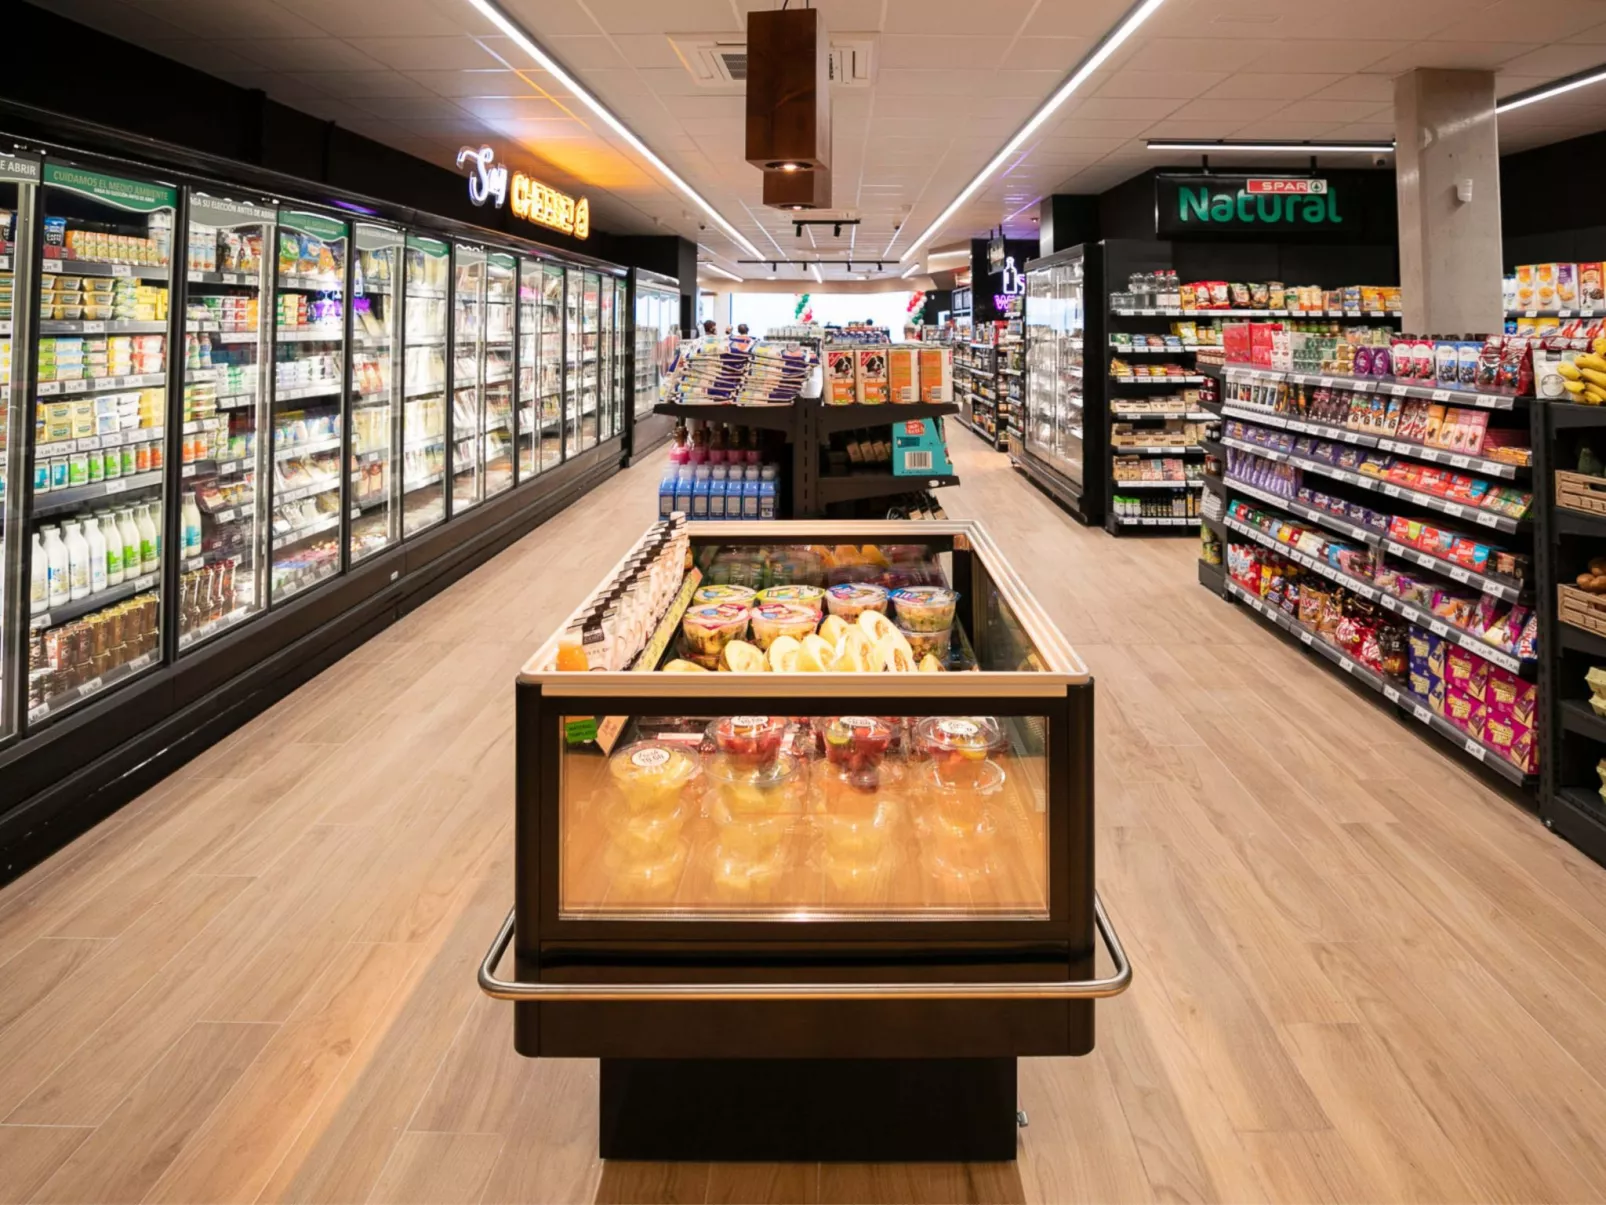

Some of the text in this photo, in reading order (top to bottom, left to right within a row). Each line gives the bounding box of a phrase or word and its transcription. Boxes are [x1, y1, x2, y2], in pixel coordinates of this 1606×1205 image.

[7, 161, 36, 176] ABRIR
[456, 146, 508, 208] Say
[53, 170, 169, 201] CUIDAMOS EL MEDIO AMBIENTE
[1261, 181, 1308, 191] SPAR
[1178, 186, 1343, 223] Natural
